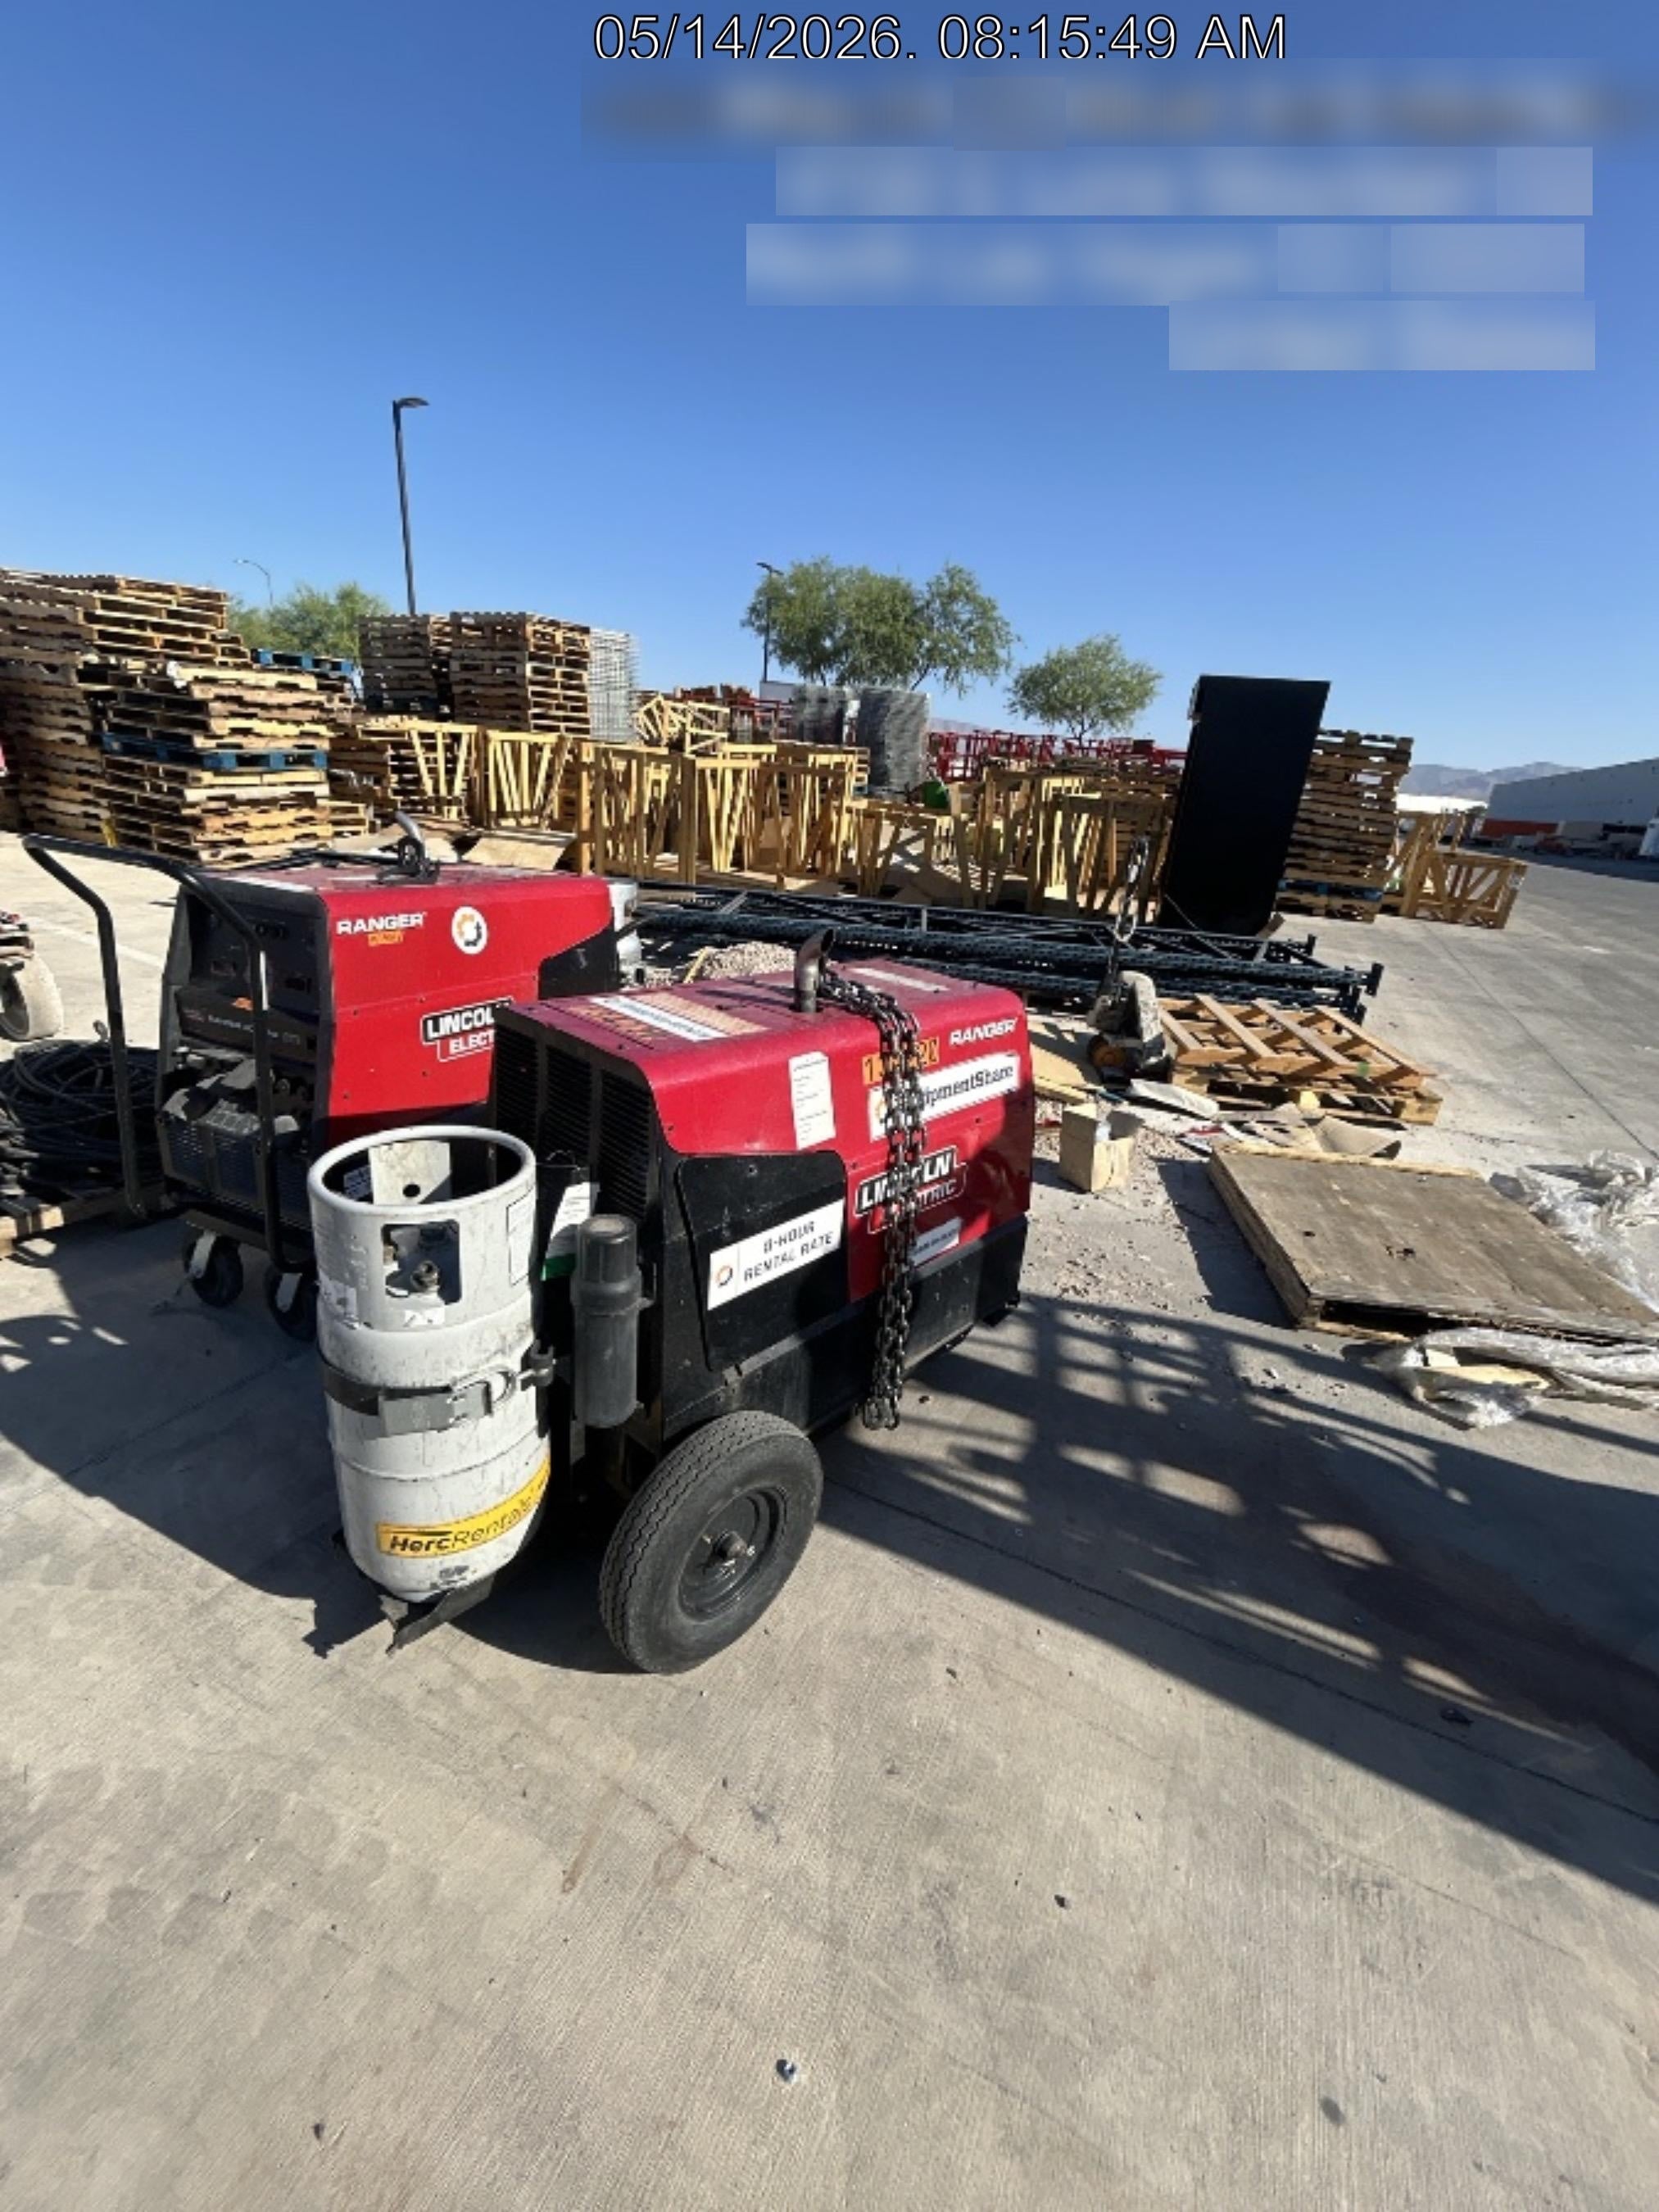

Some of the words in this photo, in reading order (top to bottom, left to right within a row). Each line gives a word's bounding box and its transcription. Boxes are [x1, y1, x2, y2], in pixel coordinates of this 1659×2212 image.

[337, 913, 424, 934] RANGER
[427, 1004, 507, 1039] LINCOL
[950, 1019, 1017, 1045] RANGER
[744, 1249, 795, 1281] RENTAL
[800, 1231, 833, 1256] RATE
